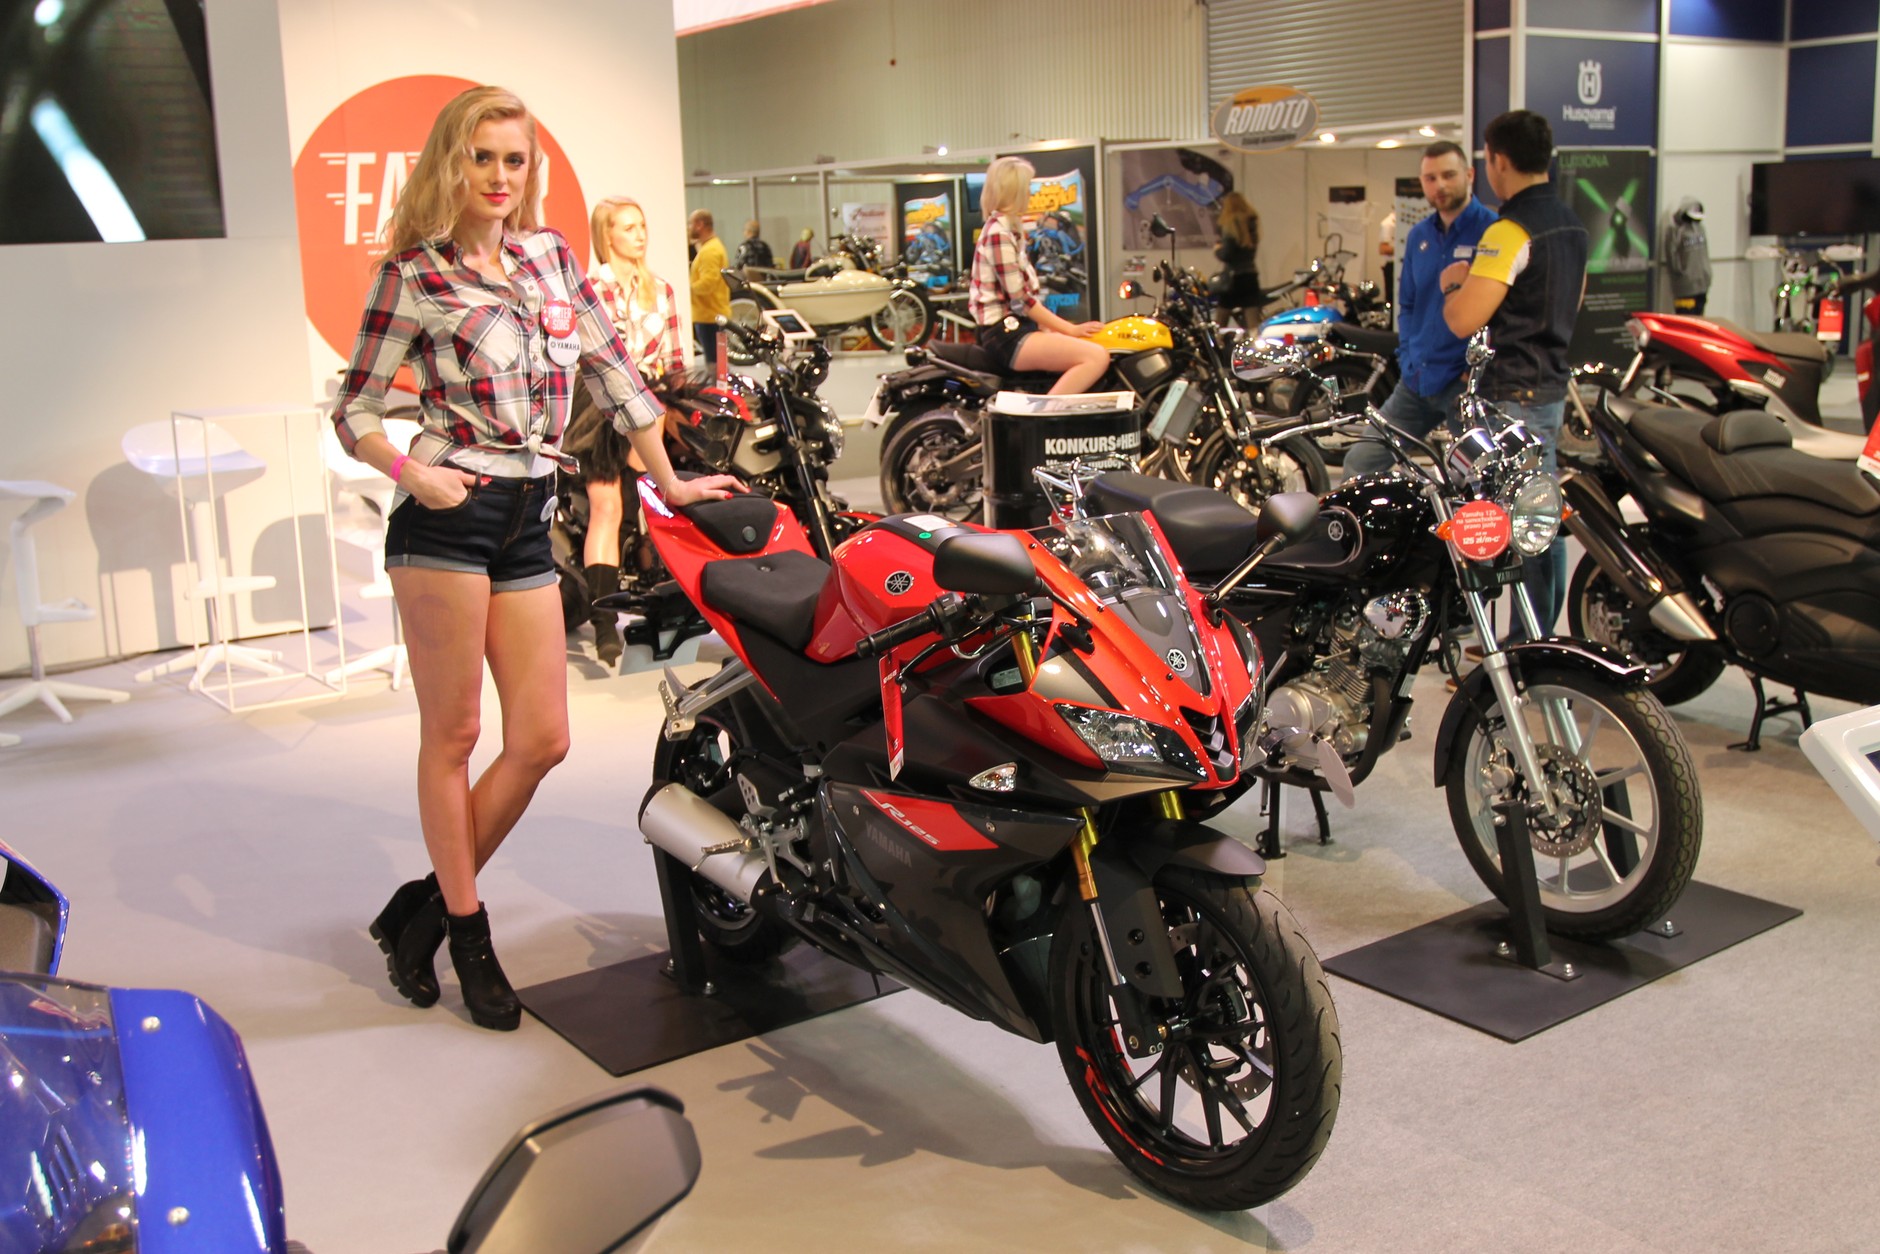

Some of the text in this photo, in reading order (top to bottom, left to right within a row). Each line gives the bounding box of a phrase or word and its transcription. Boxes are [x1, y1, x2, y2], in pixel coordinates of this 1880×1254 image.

[1223, 98, 1310, 135] RDMOTO
[557, 342, 580, 351] YAMAHA
[1045, 435, 1117, 455] KONKURS
[865, 821, 912, 868] YAMAHA
